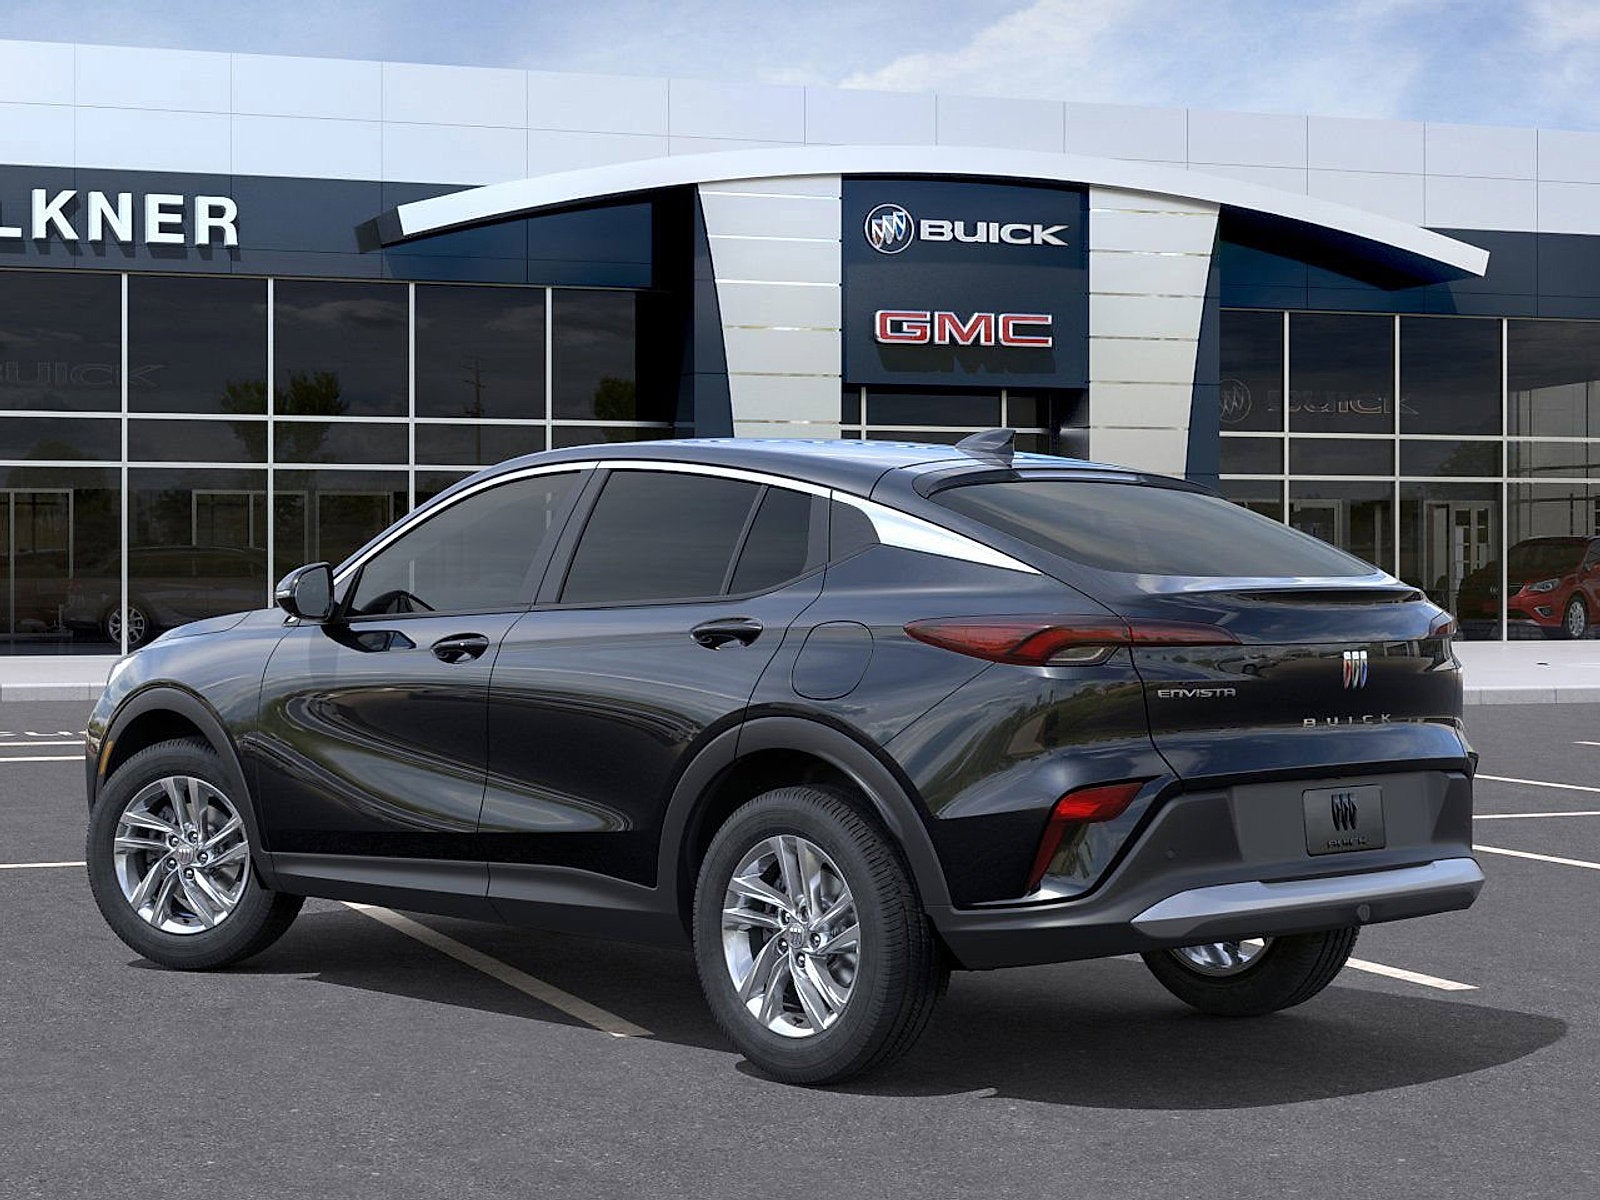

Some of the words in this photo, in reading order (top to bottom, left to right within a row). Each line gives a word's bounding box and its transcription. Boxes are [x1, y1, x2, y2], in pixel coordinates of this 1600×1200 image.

[0, 188, 239, 246] KNER
[919, 219, 1069, 247] BUICK
[875, 310, 1053, 348] GMC
[1157, 687, 1237, 699] ENVISTA
[1303, 713, 1393, 728] BUICK
